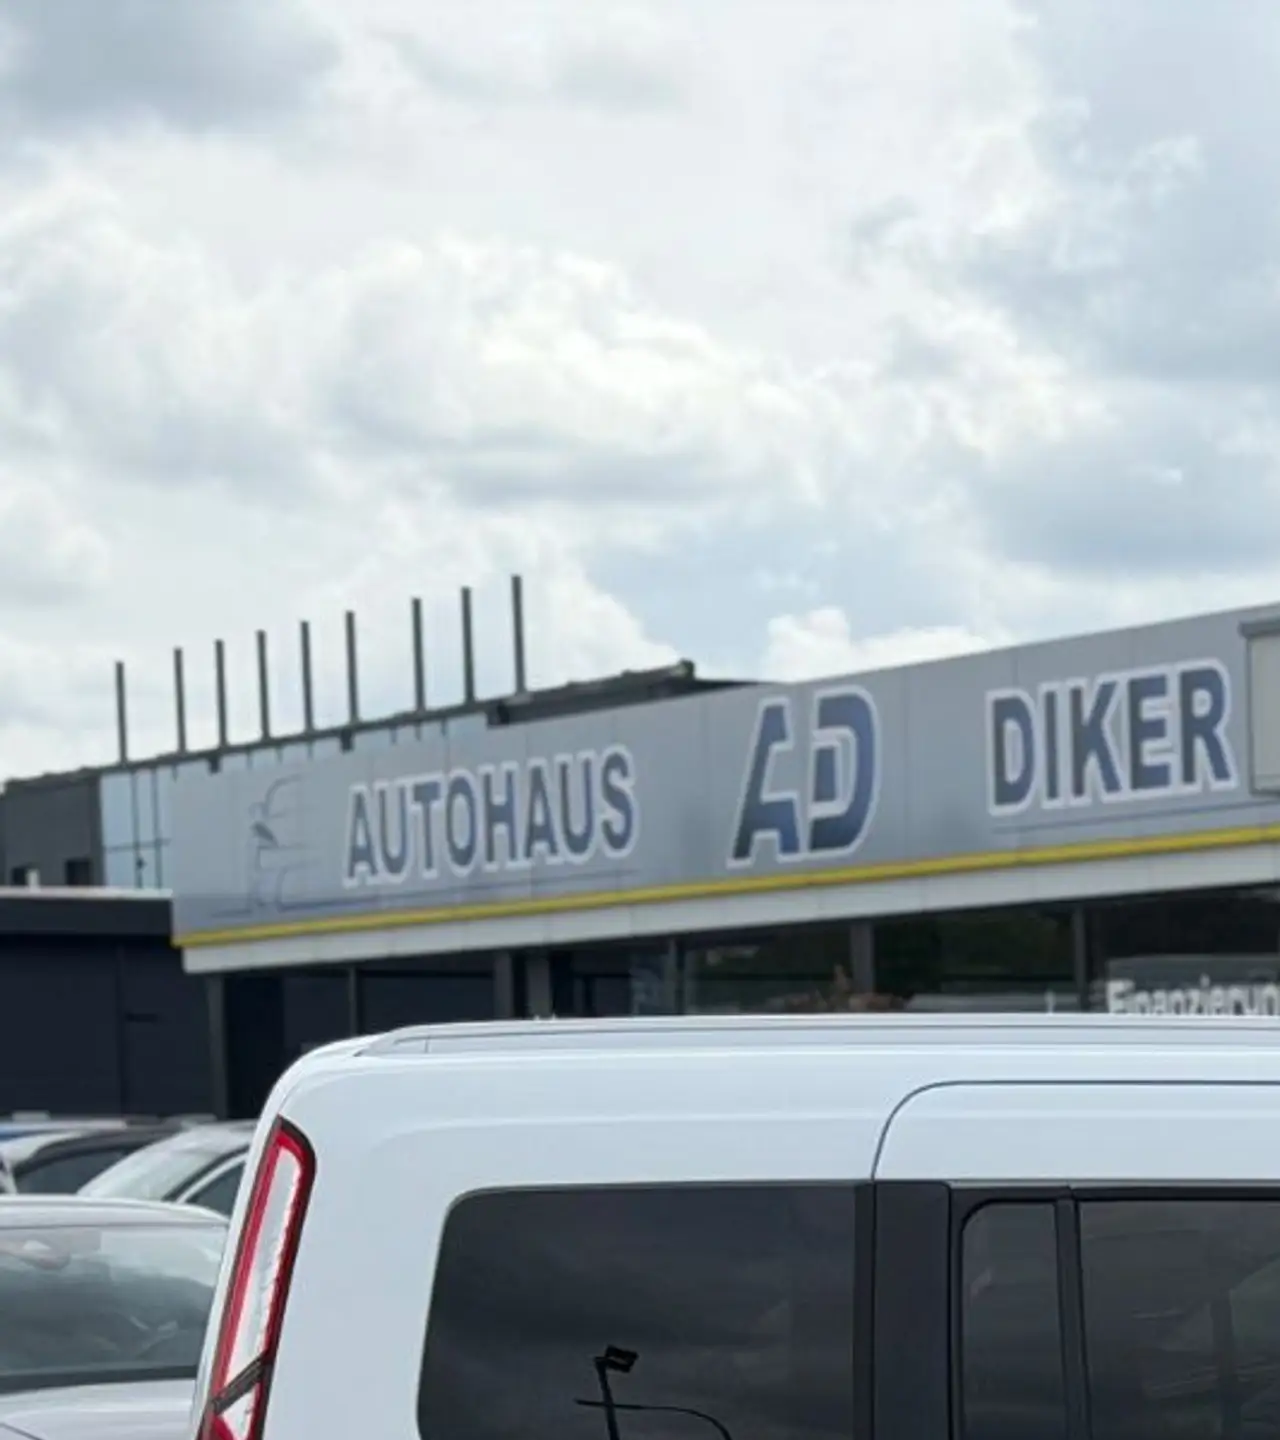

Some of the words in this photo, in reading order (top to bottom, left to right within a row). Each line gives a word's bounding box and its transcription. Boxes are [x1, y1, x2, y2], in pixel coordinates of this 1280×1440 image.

[342, 744, 639, 888] AUTOHAUS
[727, 686, 881, 868] AD
[986, 657, 1239, 816] DIKER
